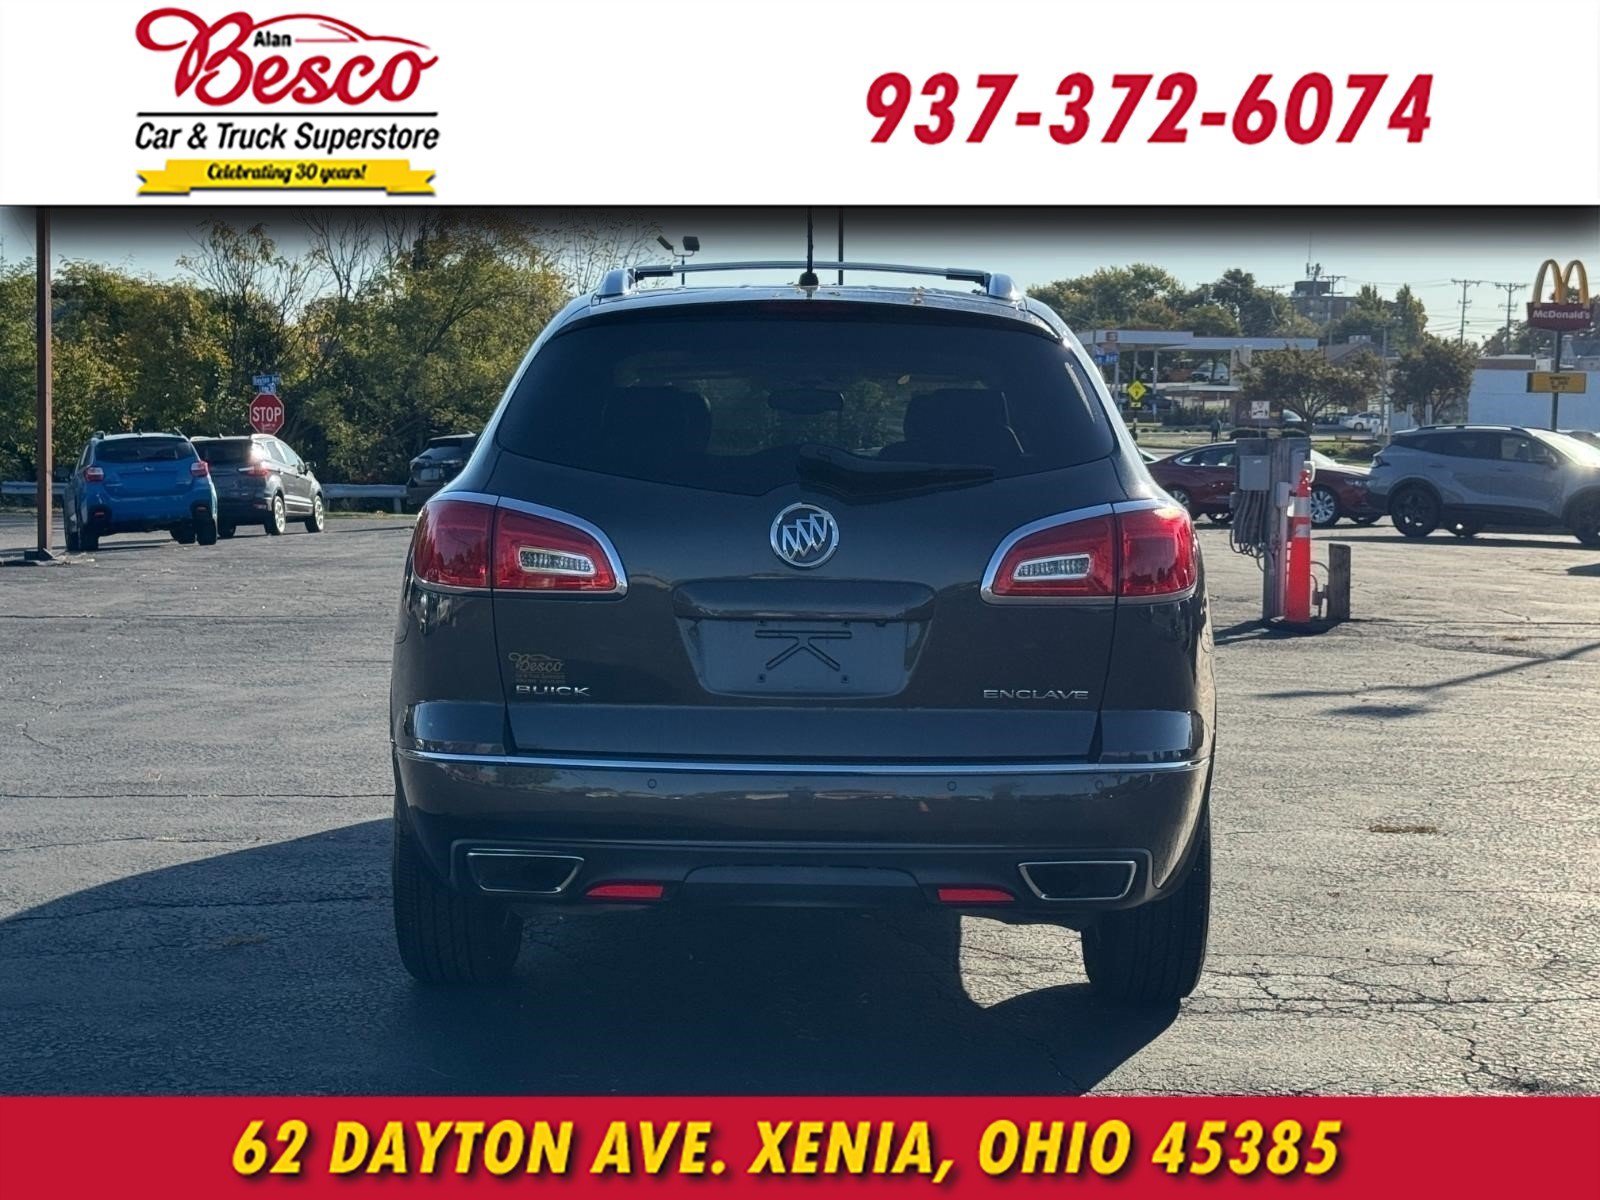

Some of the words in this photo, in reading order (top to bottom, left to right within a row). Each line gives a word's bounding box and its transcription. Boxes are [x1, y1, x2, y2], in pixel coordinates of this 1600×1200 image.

[1532, 310, 1591, 320] McDonald's
[252, 406, 282, 422] STOP
[515, 685, 592, 696] BUICK
[983, 689, 1089, 700] ENCLAVE
